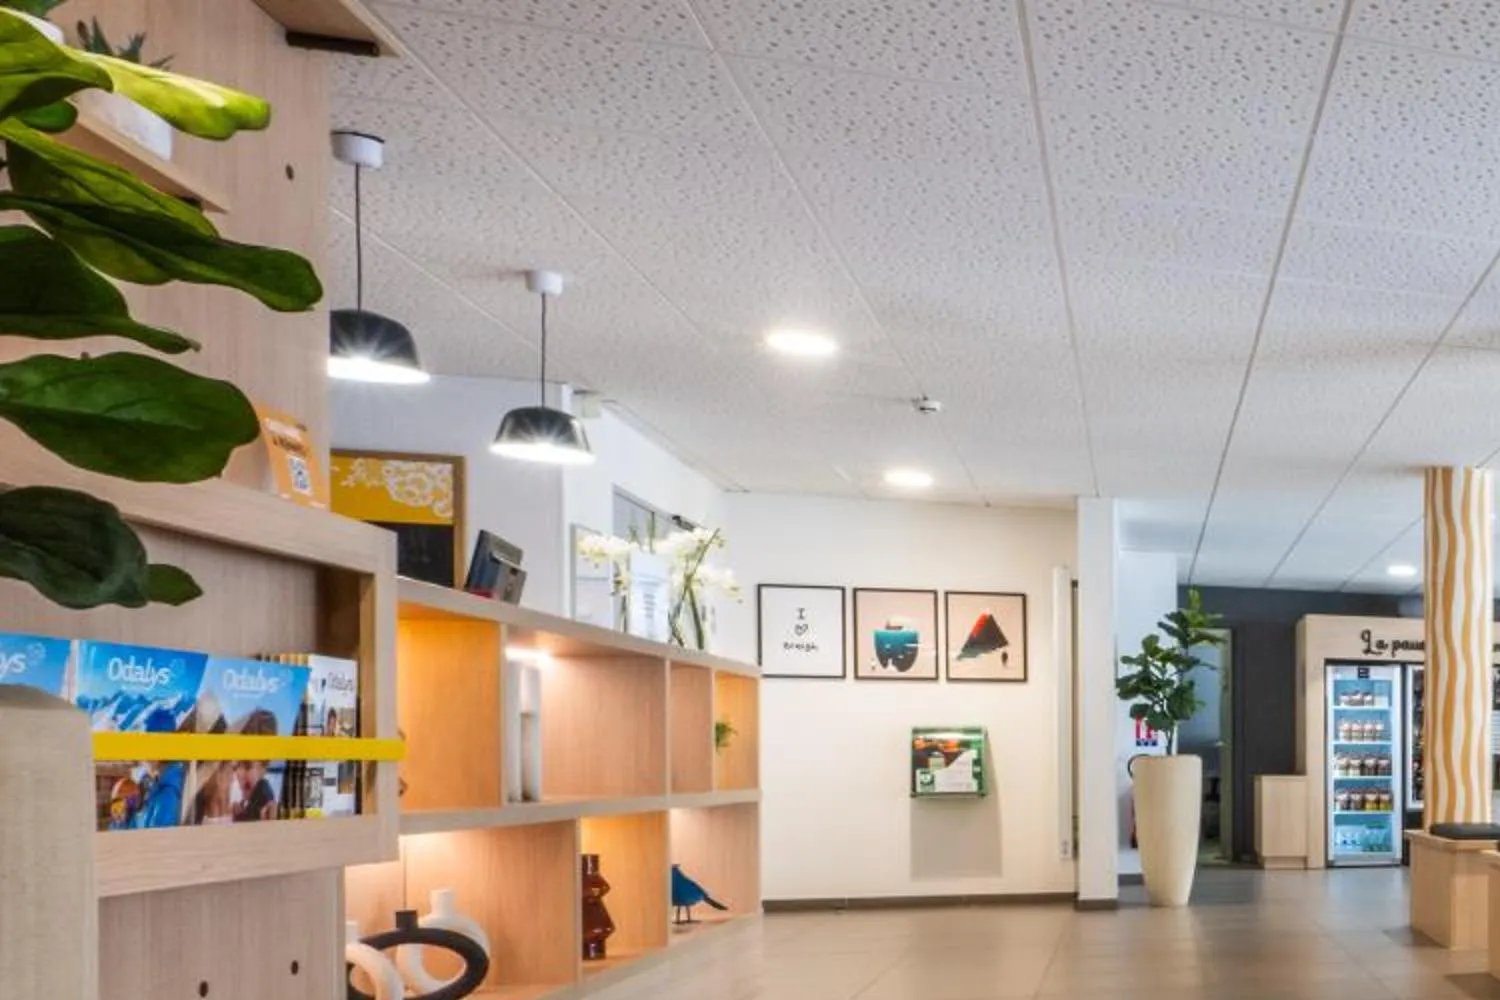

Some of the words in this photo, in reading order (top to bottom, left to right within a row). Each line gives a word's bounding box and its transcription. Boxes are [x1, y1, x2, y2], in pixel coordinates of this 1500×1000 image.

[1361, 629, 1389, 655] La
[108, 656, 171, 689] Odalys
[223, 666, 281, 696] Odalys
